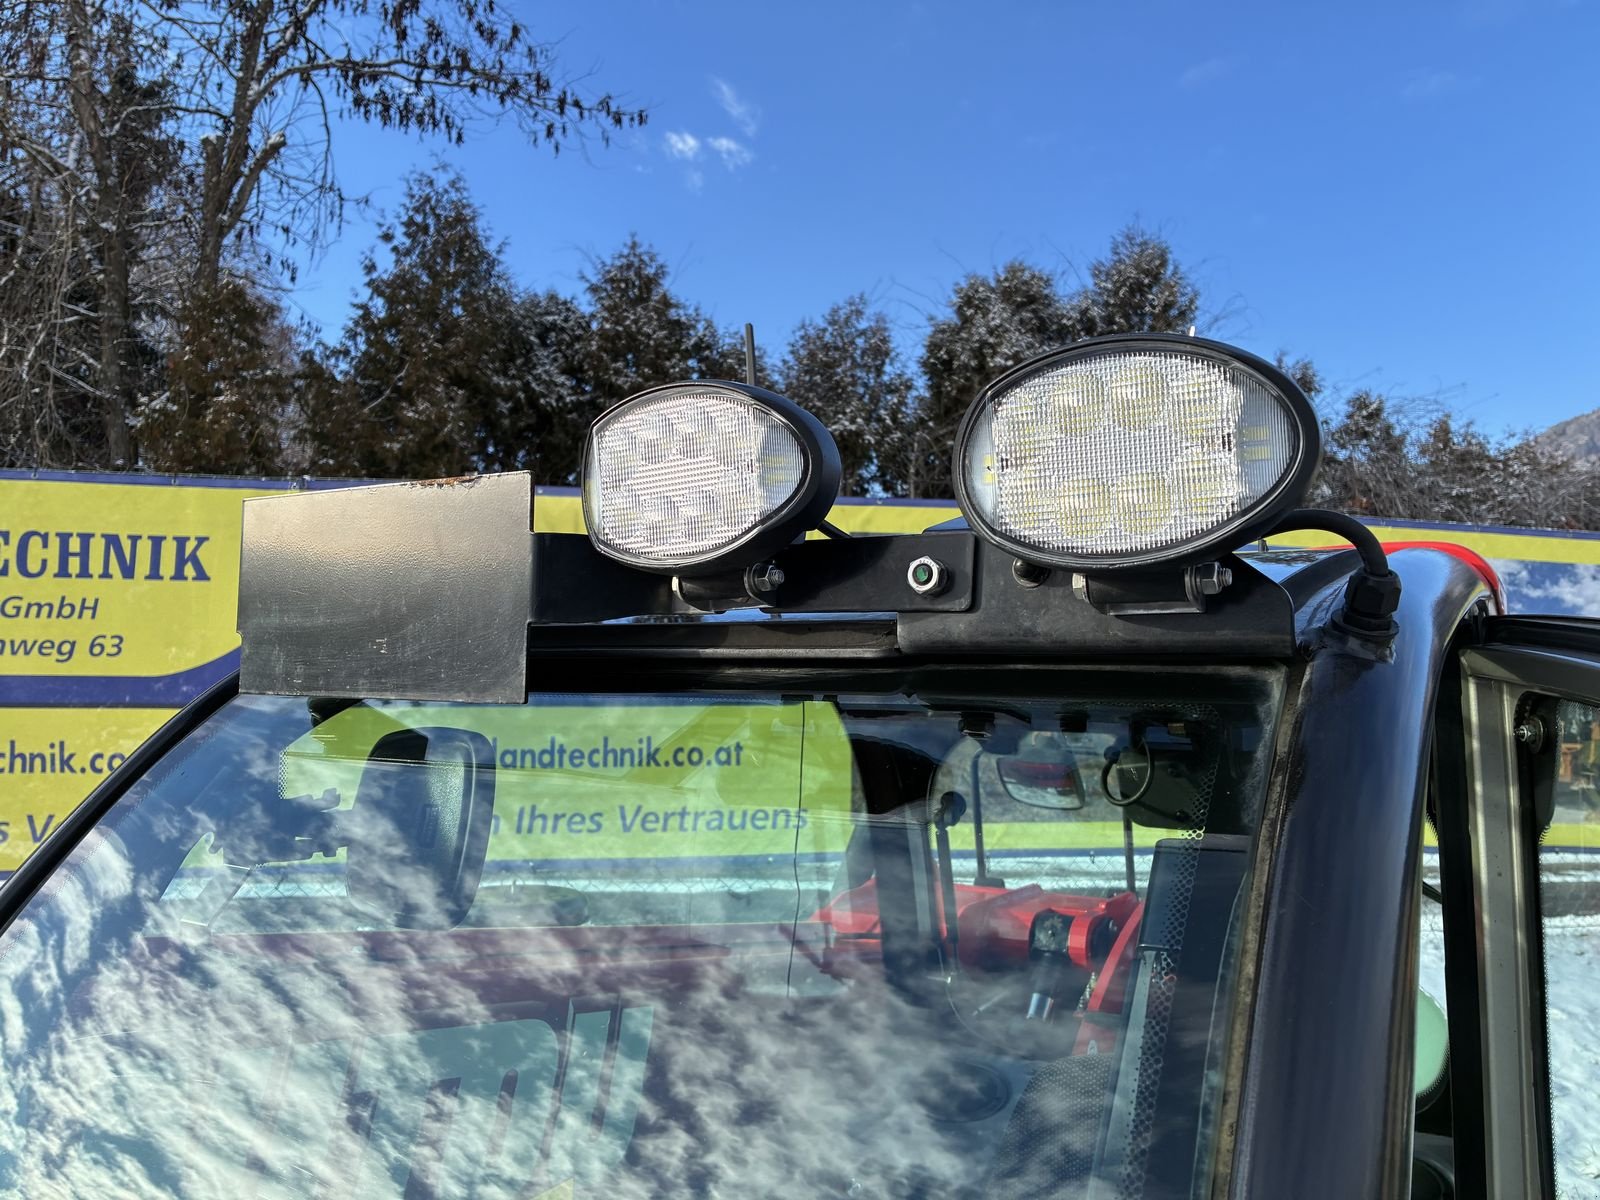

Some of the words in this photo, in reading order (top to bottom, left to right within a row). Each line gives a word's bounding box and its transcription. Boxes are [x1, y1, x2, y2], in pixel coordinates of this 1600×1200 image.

[0, 595, 100, 620] GmbH
[88, 634, 124, 657] 63
[515, 803, 605, 835] Ihres
[618, 803, 809, 834] Vertrauens
